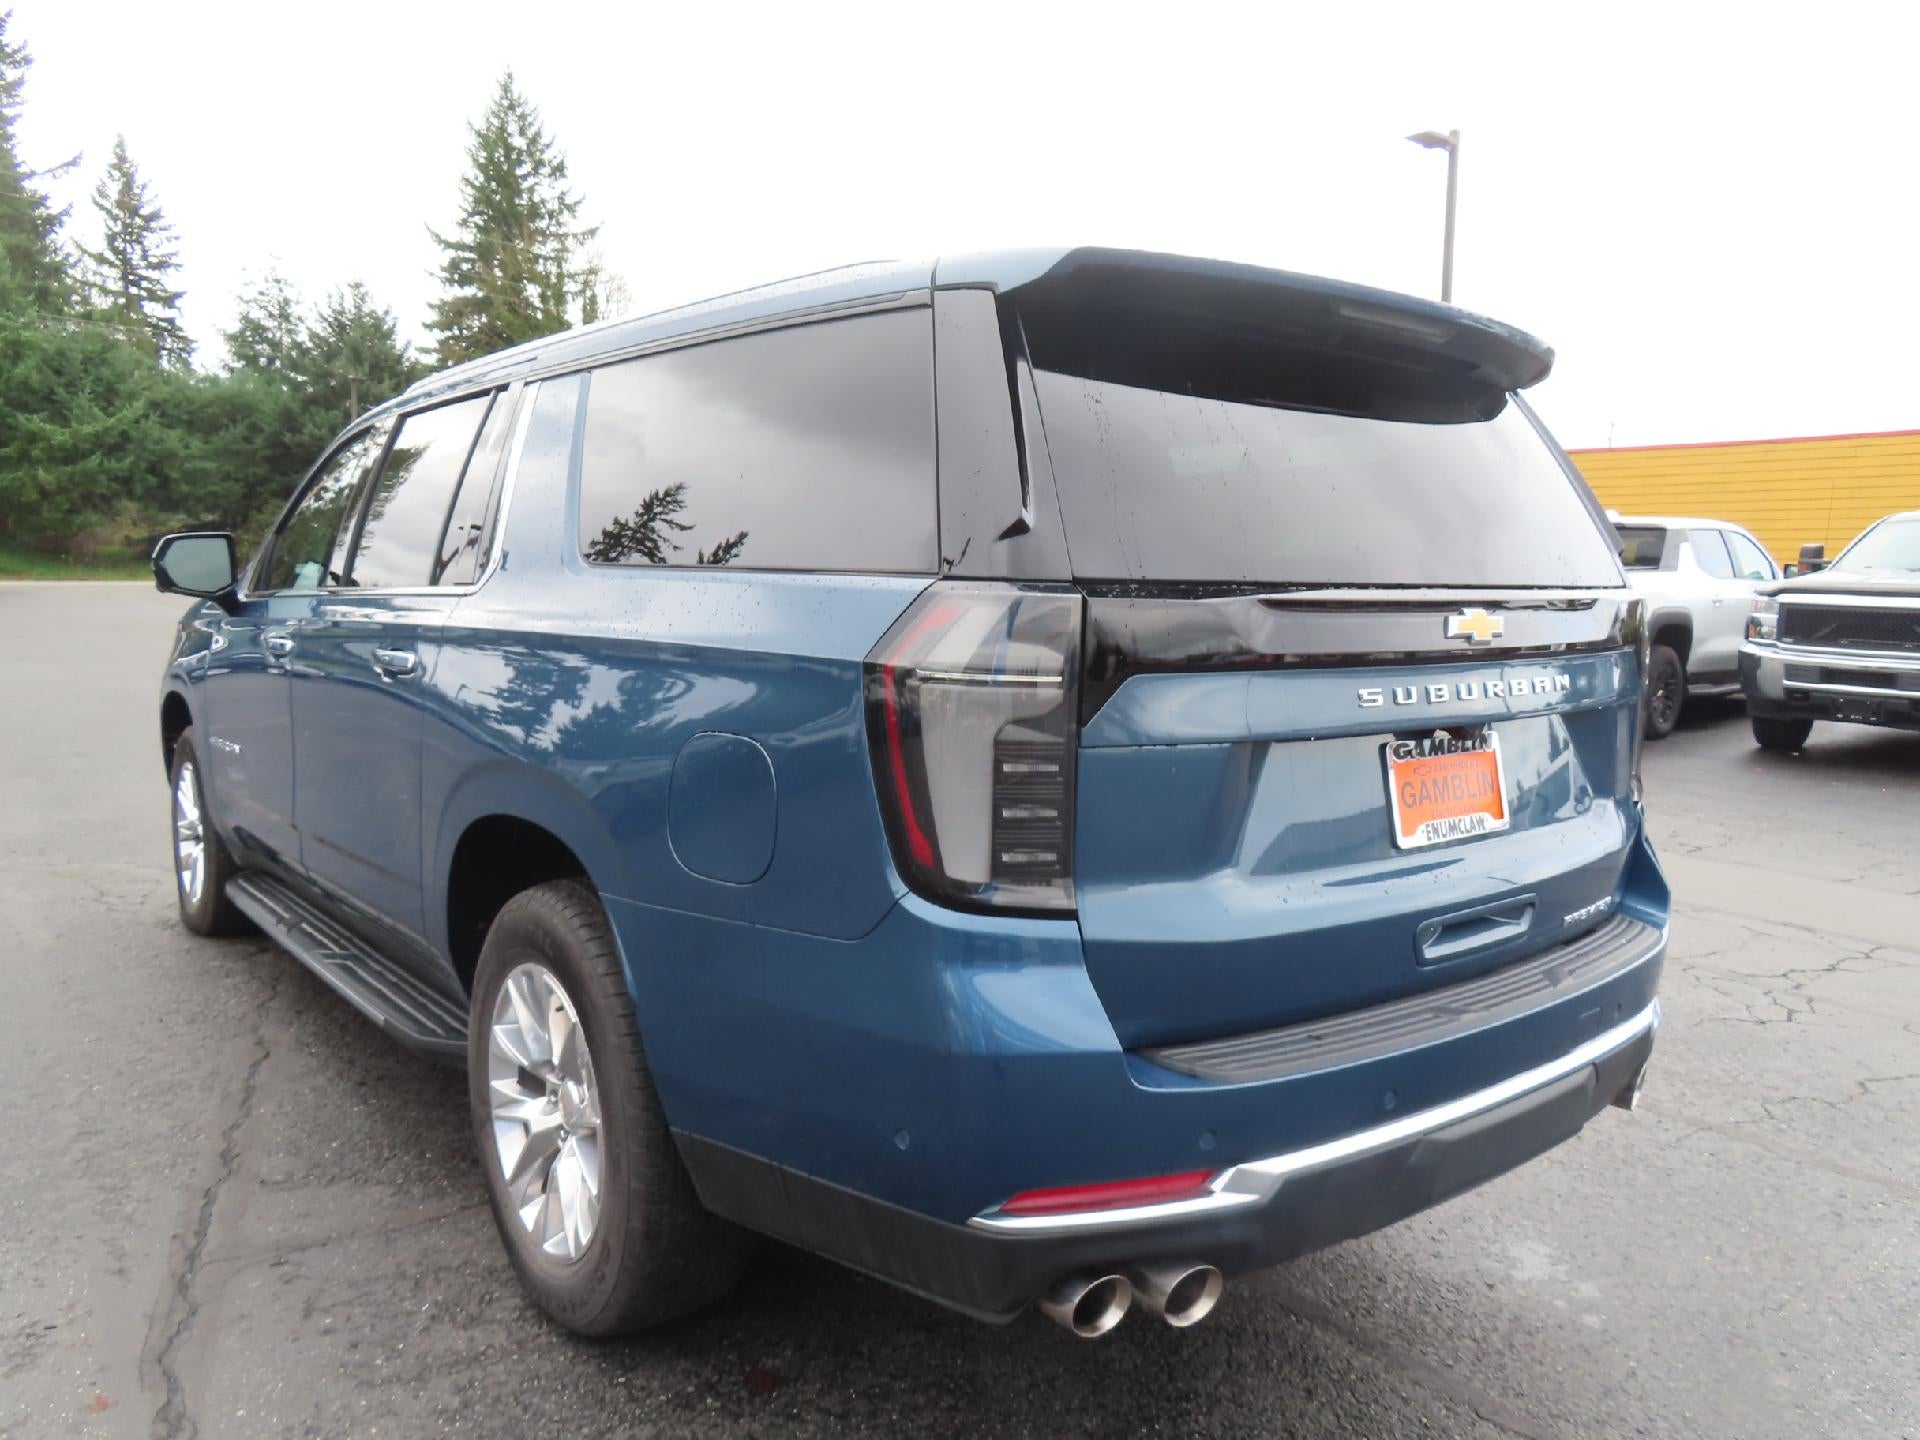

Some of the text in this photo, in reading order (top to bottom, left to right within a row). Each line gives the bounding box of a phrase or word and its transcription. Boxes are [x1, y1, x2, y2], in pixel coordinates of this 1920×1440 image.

[1358, 673, 1570, 707] SUBURBAN
[1401, 769, 1494, 808] GAMBLIN
[1425, 814, 1486, 842] ENUMCLAW
